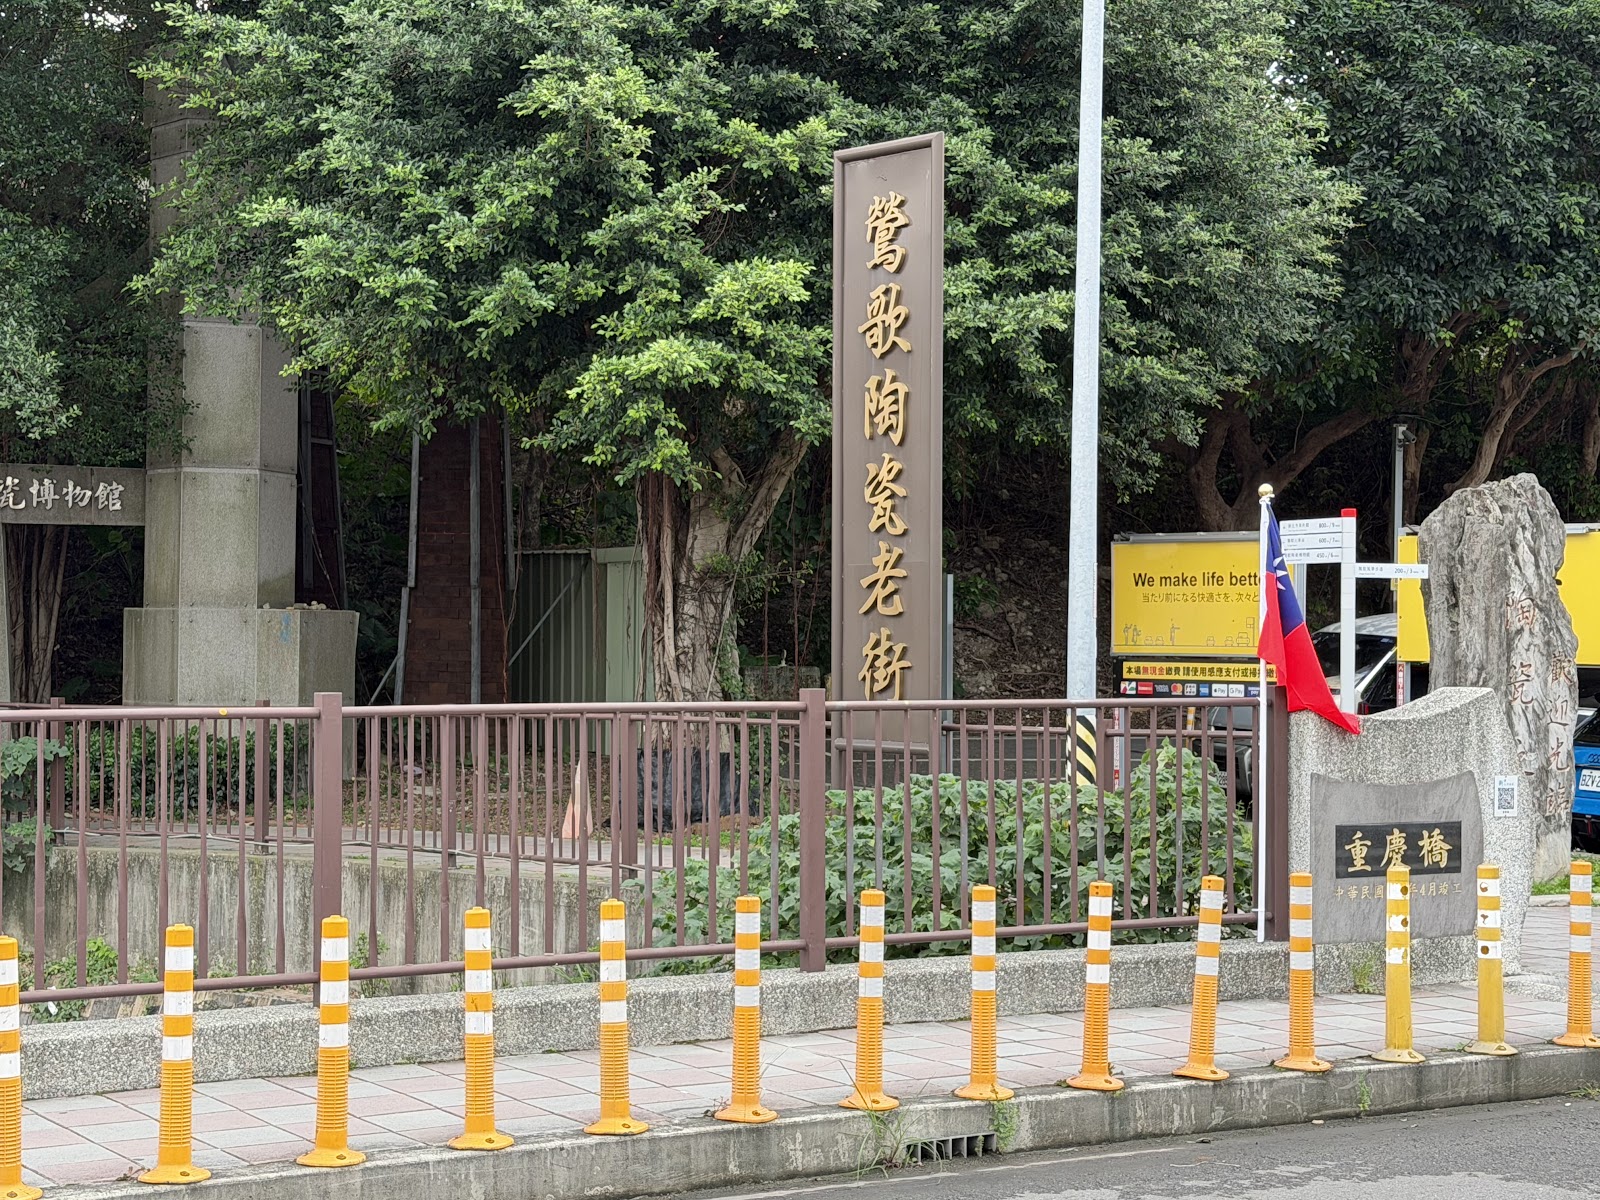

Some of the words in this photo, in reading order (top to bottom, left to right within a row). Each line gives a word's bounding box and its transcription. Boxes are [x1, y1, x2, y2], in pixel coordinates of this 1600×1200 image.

[857, 191, 912, 700] 鶯歌陶瓷老街
[1133, 572, 1155, 587] We
[1159, 571, 1198, 587] make
[1202, 571, 1225, 587] life
[1344, 827, 1453, 873] 重慶橋
